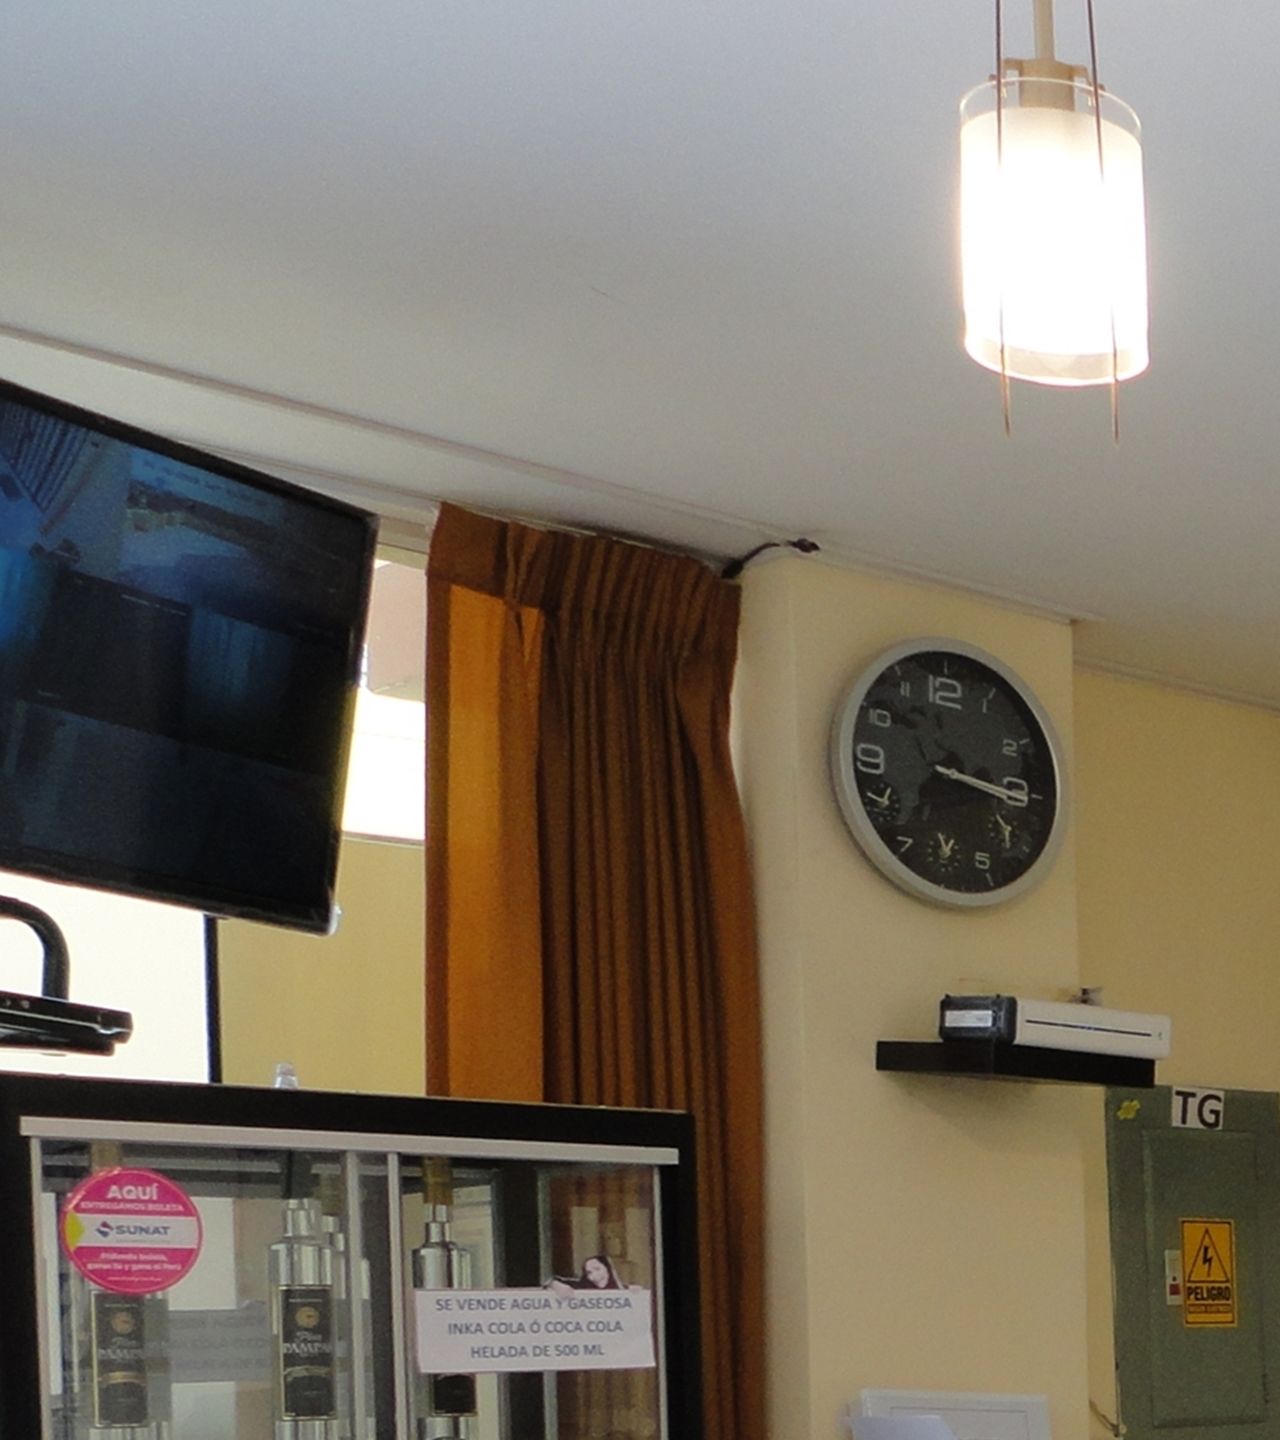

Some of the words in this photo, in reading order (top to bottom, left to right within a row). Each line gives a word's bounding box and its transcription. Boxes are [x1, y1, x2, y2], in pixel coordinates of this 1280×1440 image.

[928, 674, 963, 711] 12
[869, 708, 892, 728] 10
[1002, 739, 1018, 757] 2
[856, 743, 885, 775] 9
[897, 835, 914, 853] 7
[975, 852, 992, 870] 5
[1174, 1090, 1222, 1129] TG
[115, 1225, 170, 1236] SUNAT
[1186, 1285, 1232, 1301] PELIGRO
[435, 1298, 453, 1311] SE
[457, 1298, 507, 1311] VENDE
[510, 1297, 551, 1310] AGUA
[556, 1297, 565, 1310] Y
[567, 1297, 633, 1310] GASEOSA
[448, 1322, 485, 1335] INKA
[487, 1321, 527, 1334] COLA
[529, 1319, 541, 1334] Ó
[544, 1320, 584, 1334] COCA
[584, 1320, 624, 1333] COLA
[470, 1345, 529, 1359] HELADA
[532, 1345, 551, 1358] DE
[554, 1344, 580, 1357] 500
[583, 1343, 606, 1356] ML
